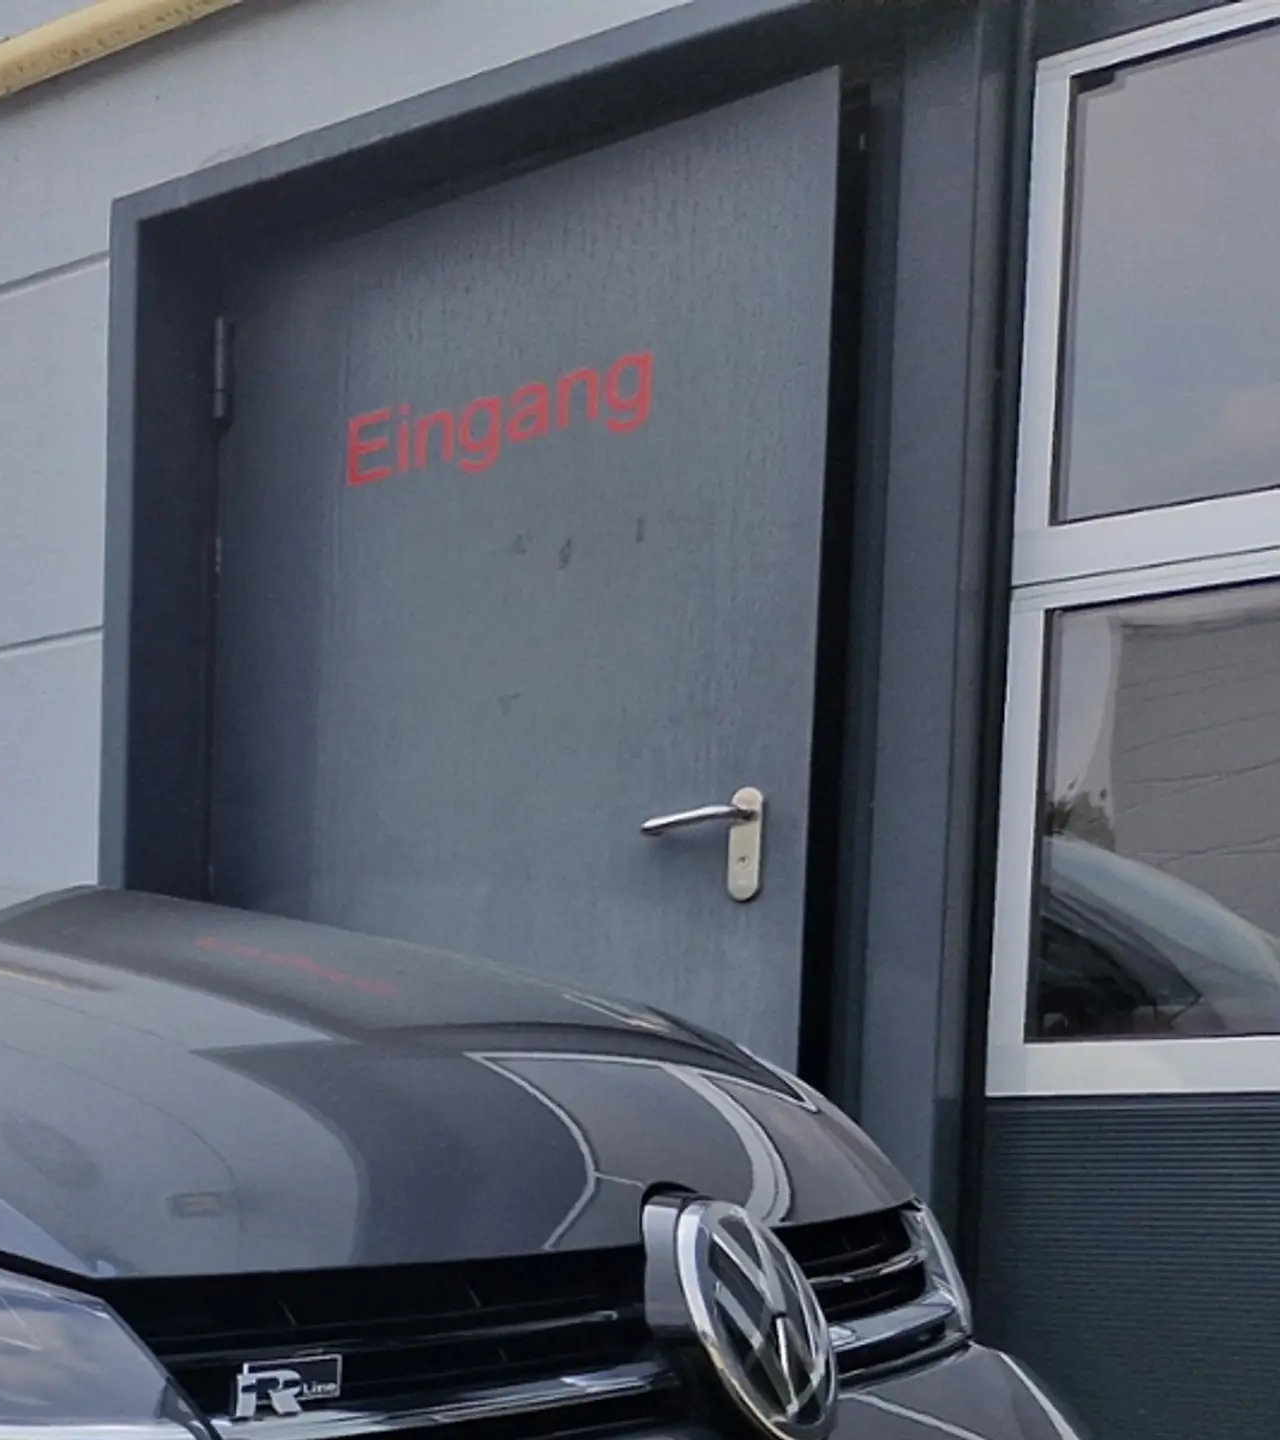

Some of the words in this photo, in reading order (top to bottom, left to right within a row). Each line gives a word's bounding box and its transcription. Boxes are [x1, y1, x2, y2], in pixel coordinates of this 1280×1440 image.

[346, 350, 653, 487] Eingang
[236, 1369, 303, 1418] R
[303, 1380, 338, 1396] Line
